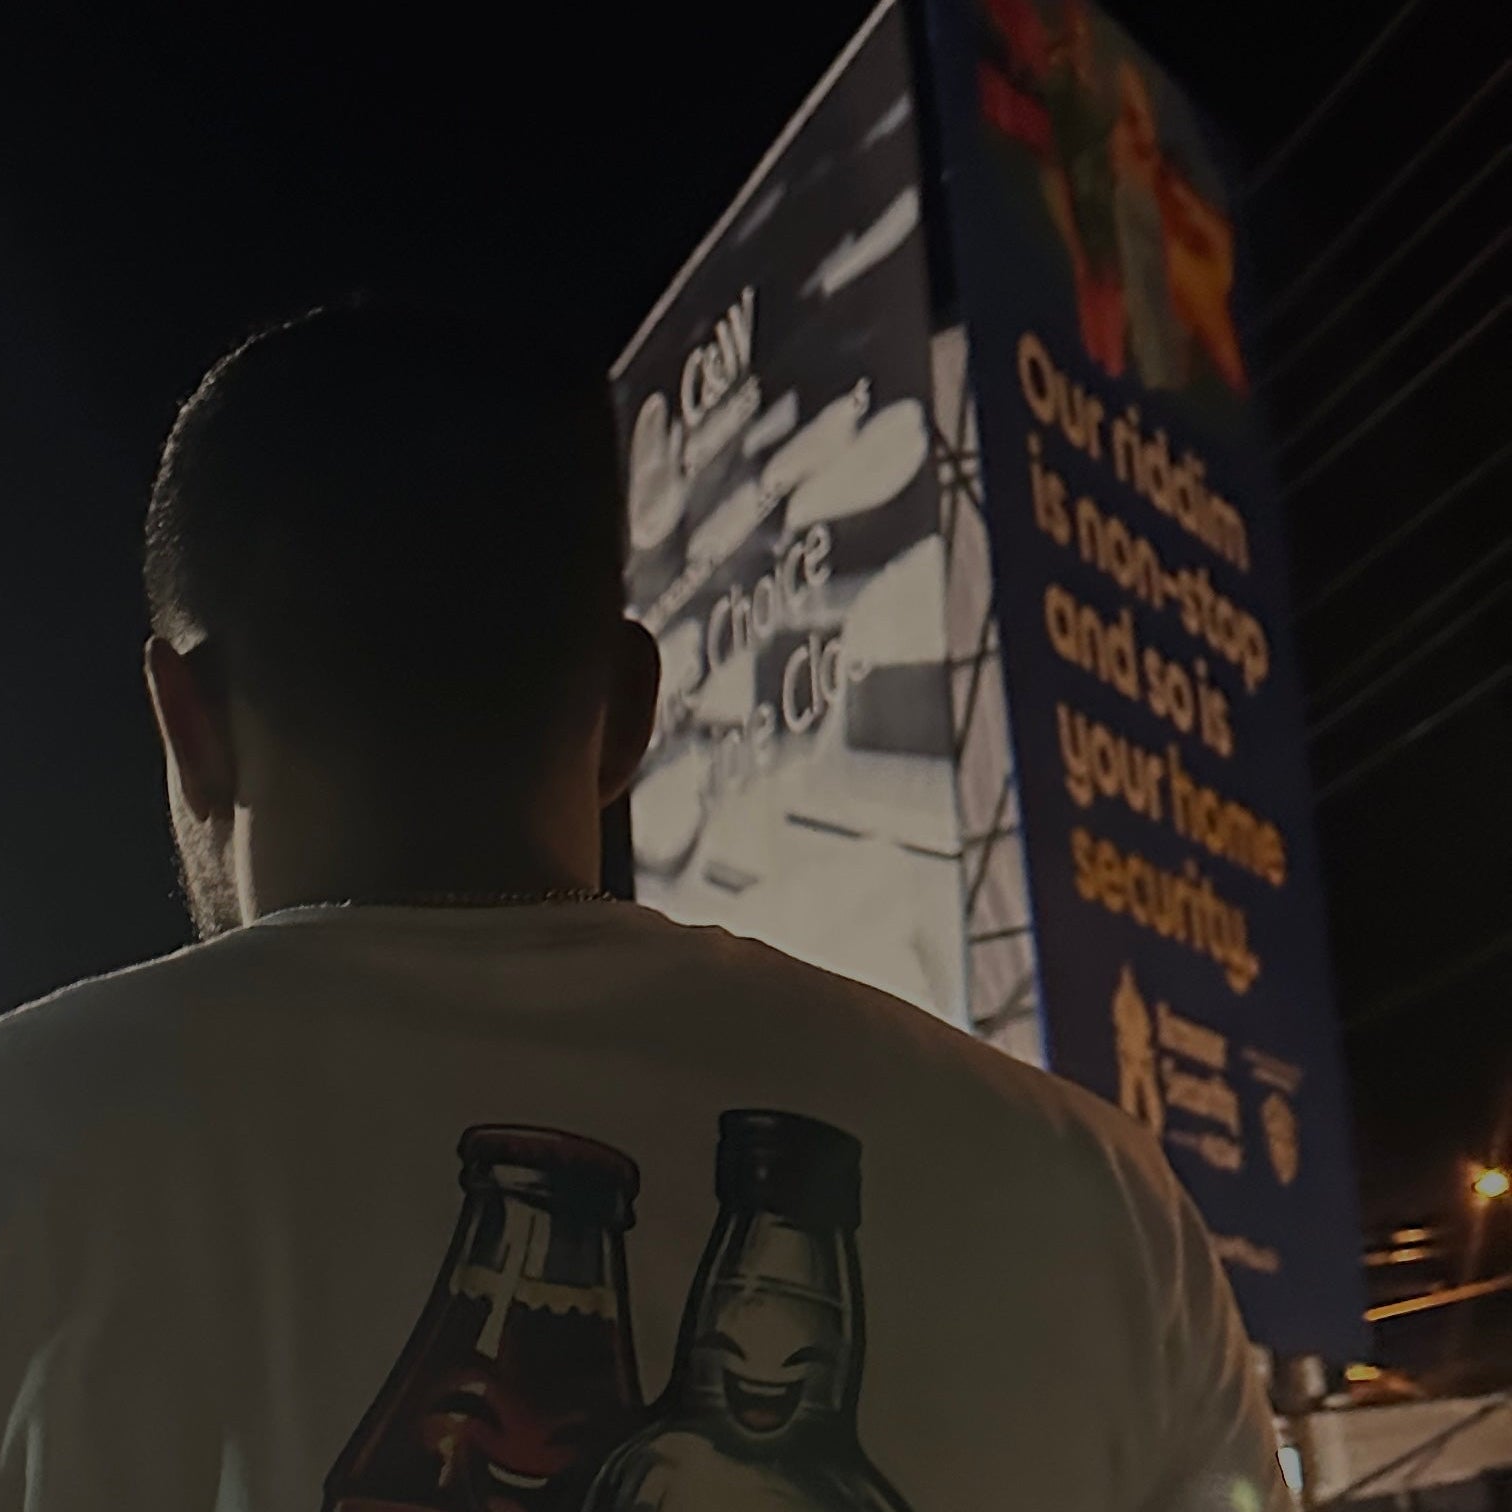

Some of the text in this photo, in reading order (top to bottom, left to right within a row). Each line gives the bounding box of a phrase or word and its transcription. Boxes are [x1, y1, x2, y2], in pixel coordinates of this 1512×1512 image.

[1017, 331, 1250, 573] Our riddim
[1027, 431, 1270, 695] is non-stop
[1044, 582, 1235, 760] and so is
[1055, 699, 1287, 889] your home
